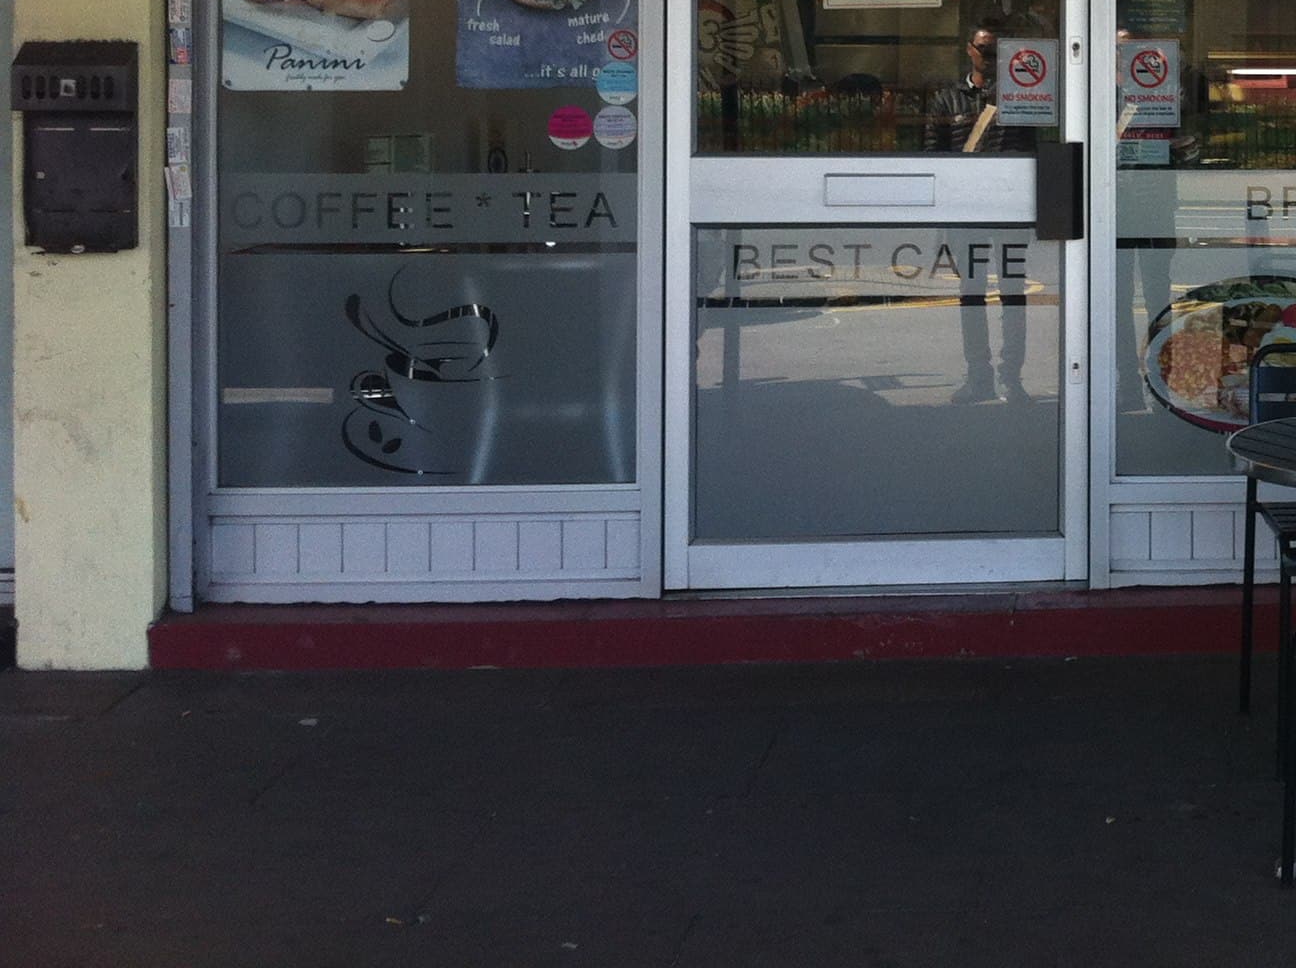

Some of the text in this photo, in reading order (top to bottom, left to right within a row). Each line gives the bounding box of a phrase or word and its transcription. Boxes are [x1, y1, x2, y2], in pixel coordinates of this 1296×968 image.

[467, 18, 500, 32] fresh
[567, 12, 610, 27] mature
[489, 32, 520, 47] salad
[263, 43, 366, 70] Panini
[569, 64, 588, 78] all
[1002, 94, 1053, 102] NO SMOKING
[1124, 94, 1175, 103] NO SMOKING
[231, 191, 619, 230] COFFEE TEA
[732, 242, 1029, 281] BEST CAFE
